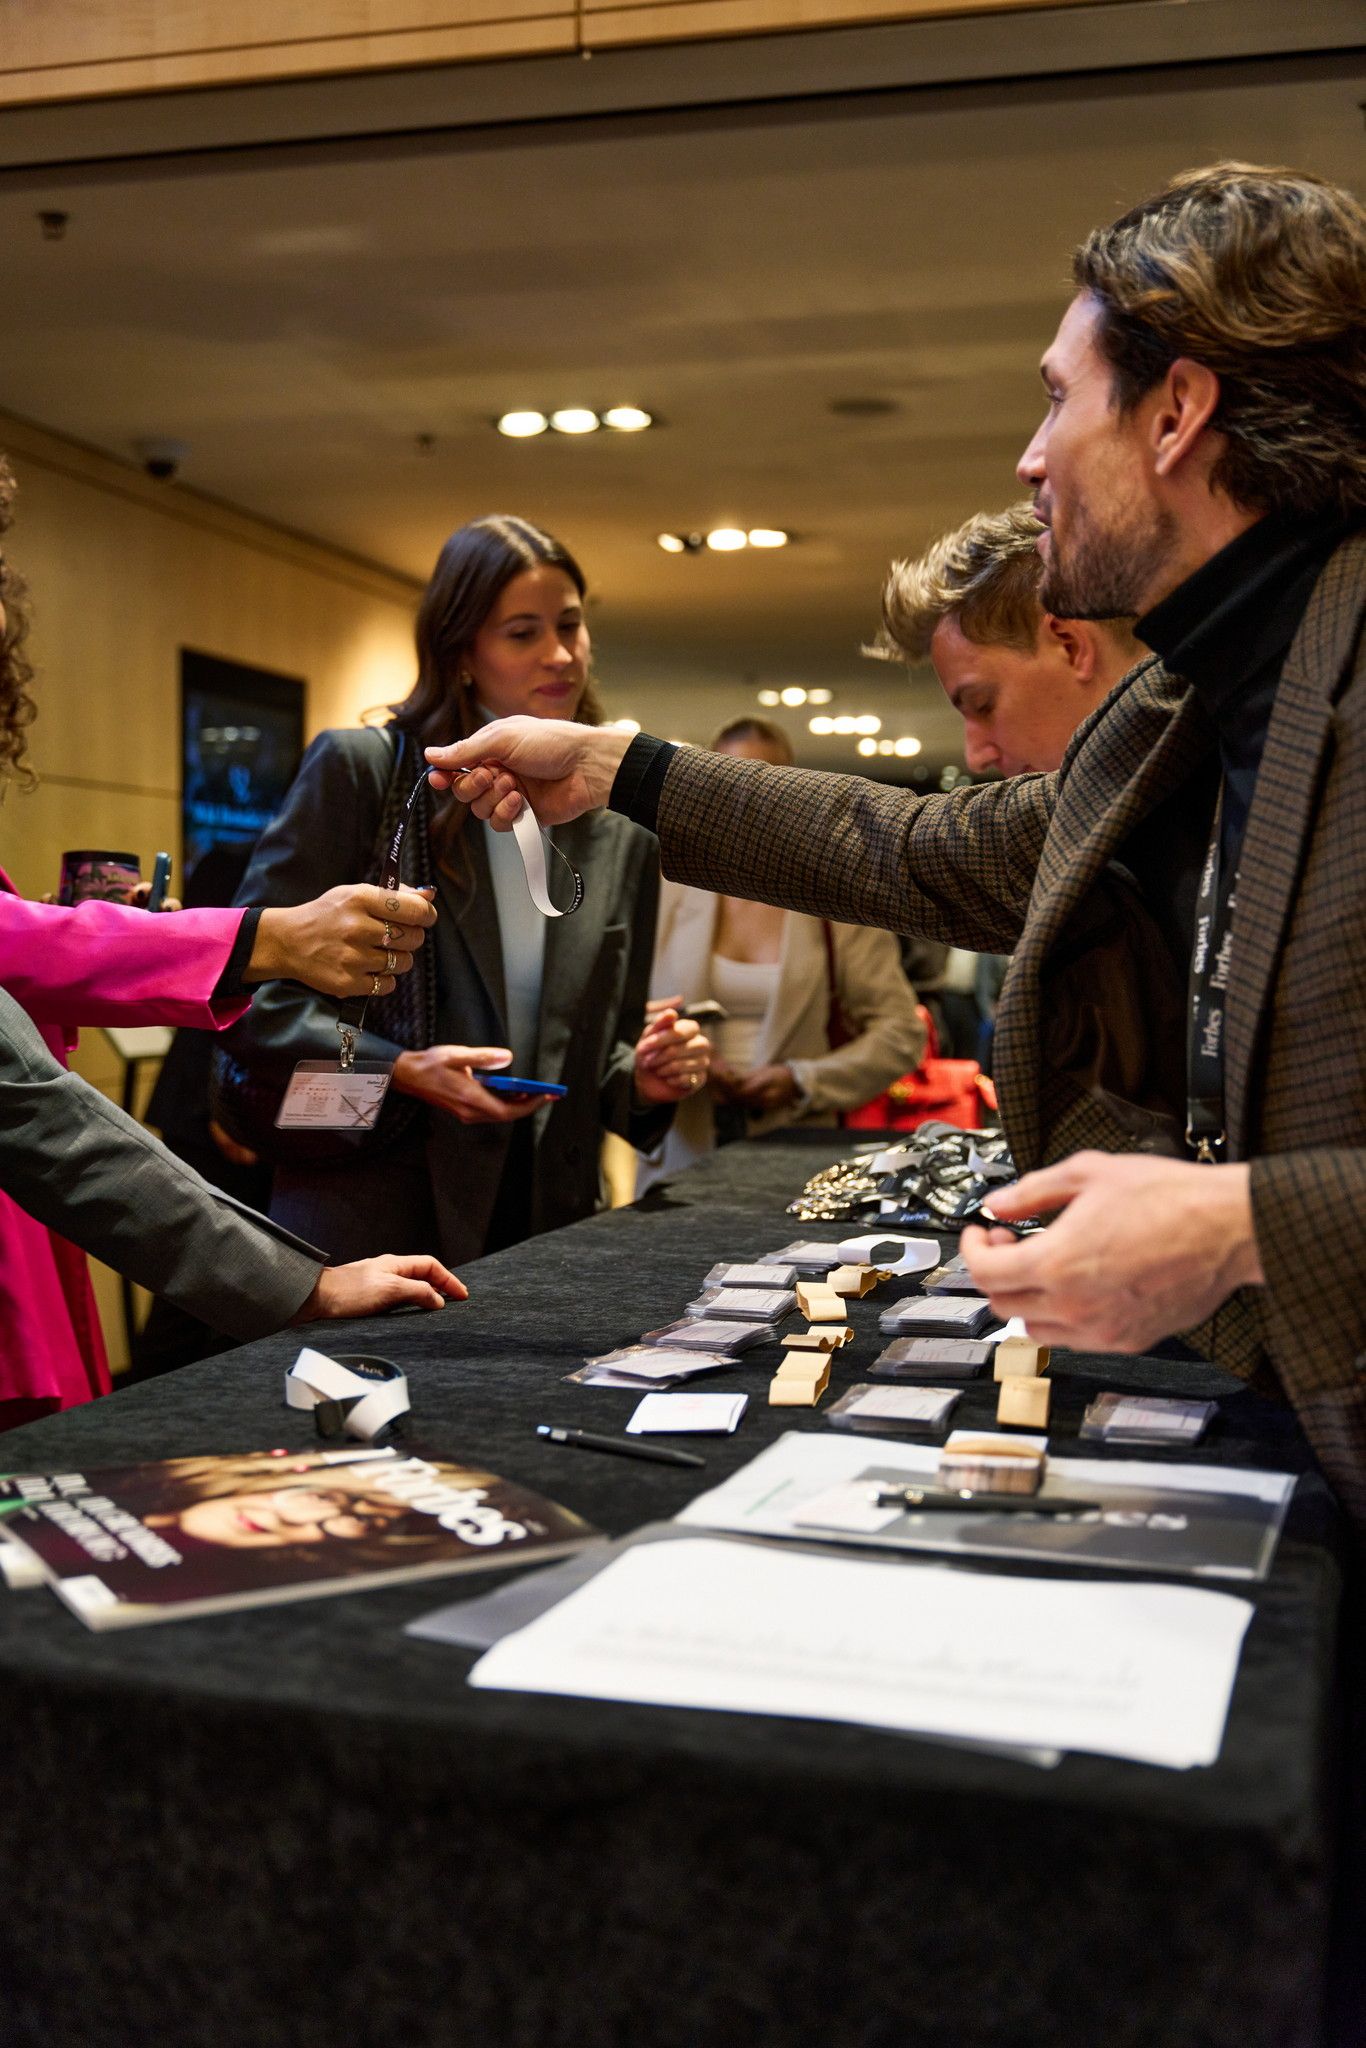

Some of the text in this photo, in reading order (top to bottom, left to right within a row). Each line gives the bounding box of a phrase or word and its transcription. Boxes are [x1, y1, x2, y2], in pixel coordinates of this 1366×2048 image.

[390, 822, 404, 863] Forbes
[1209, 931, 1234, 990] Forbes
[1201, 1008, 1223, 1058] Forbes
